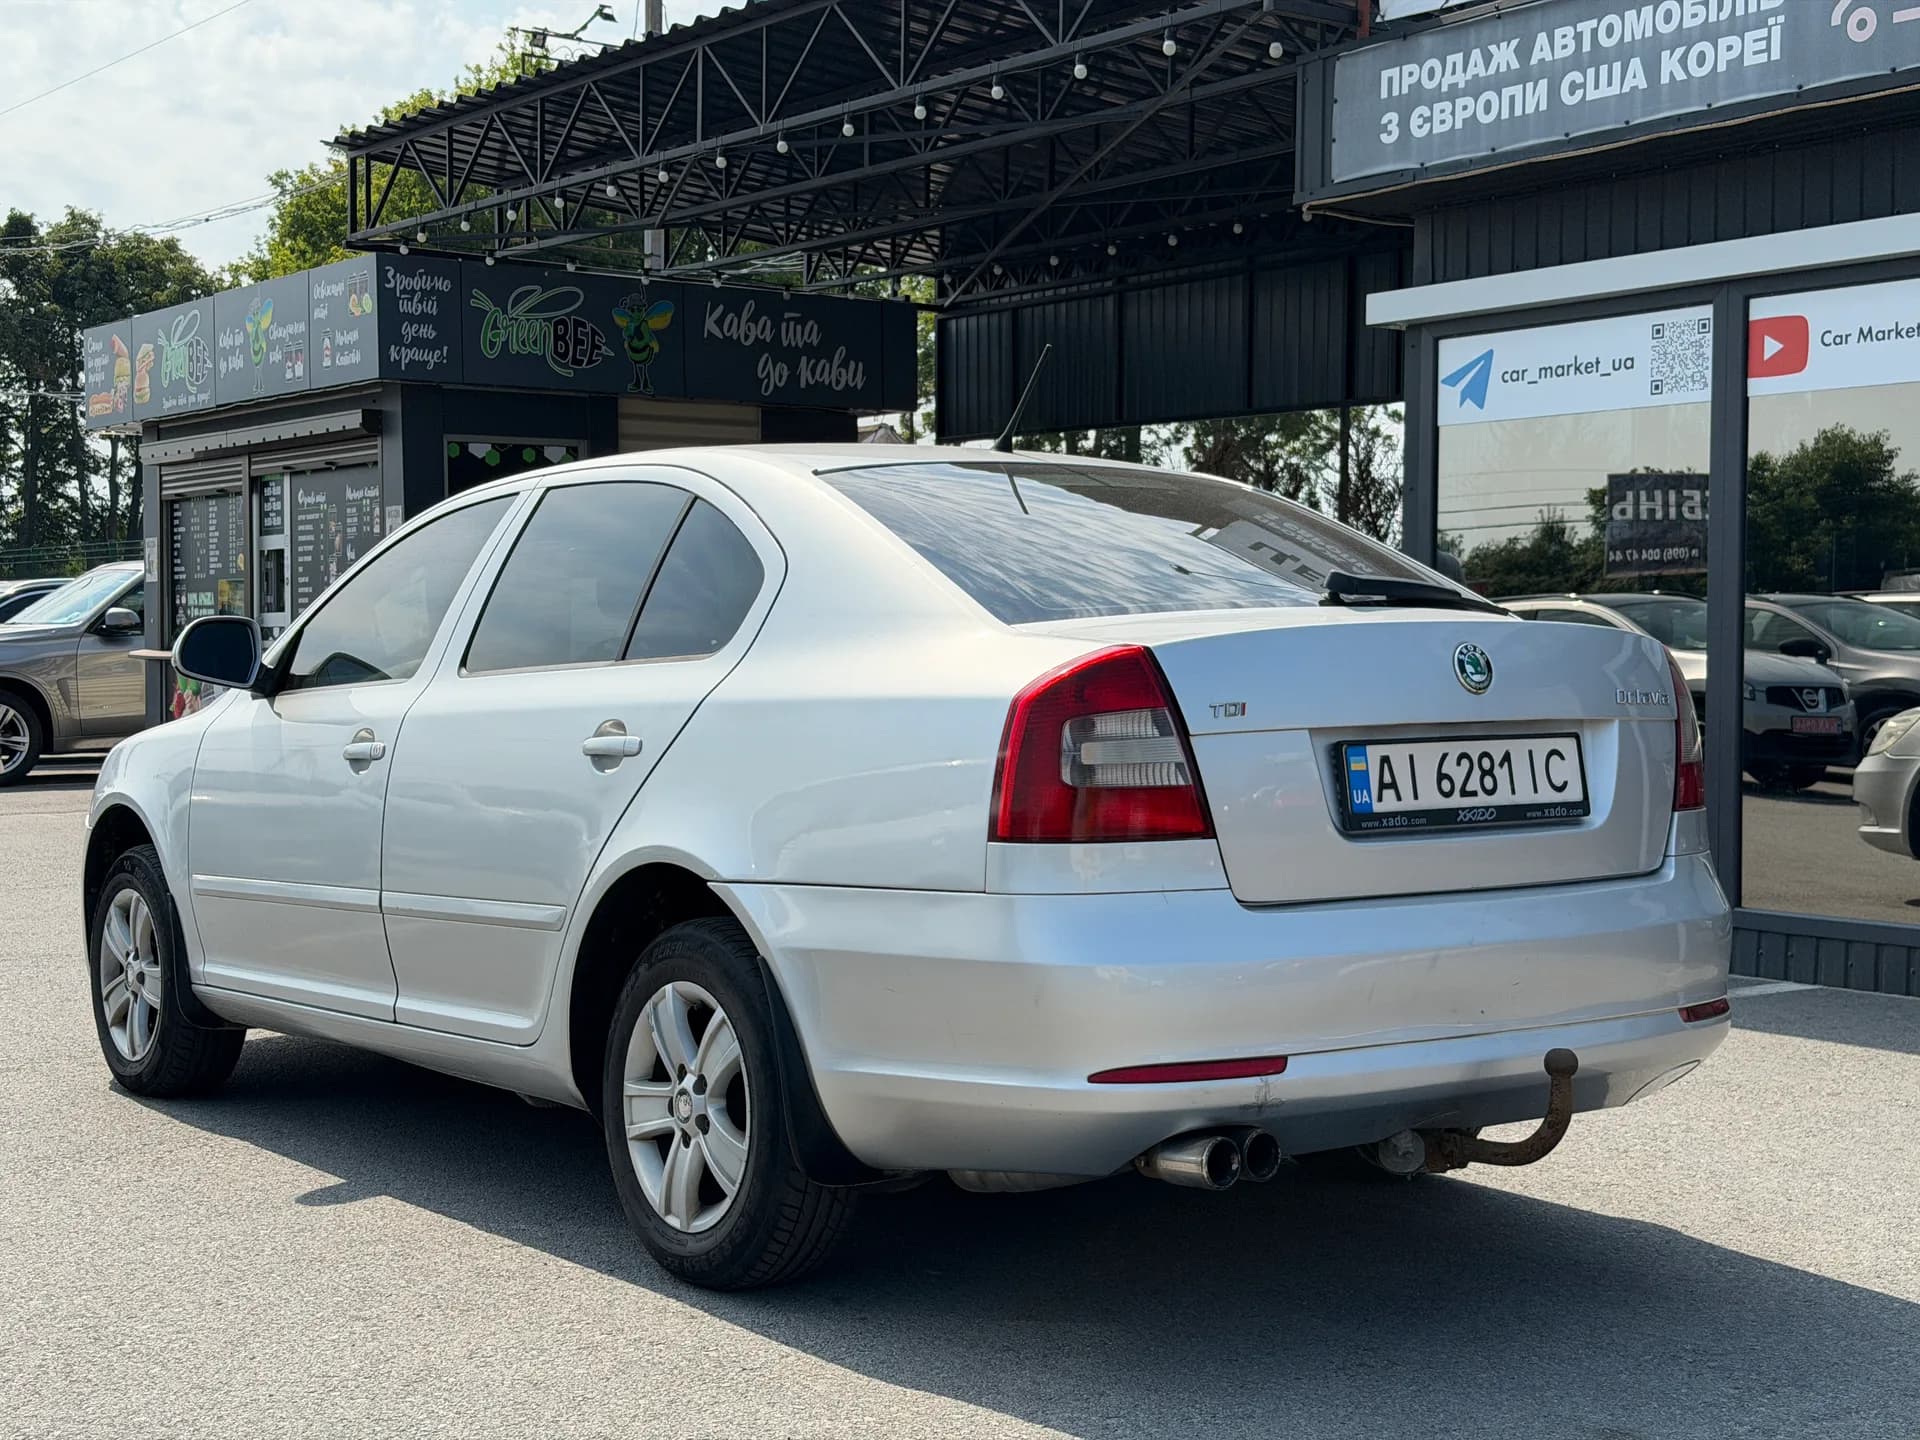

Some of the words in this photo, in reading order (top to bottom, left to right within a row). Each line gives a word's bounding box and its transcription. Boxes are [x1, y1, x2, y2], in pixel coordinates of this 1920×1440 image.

[1379, 111, 1400, 145] З
[1409, 77, 1549, 139] ЄВРОПИ
[1559, 56, 1648, 106] США
[1659, 14, 1786, 85] КОРЕЇ
[1380, 37, 1521, 100] ПРОДАЖ
[384, 265, 452, 298] Зробимо
[399, 291, 438, 316] твій
[401, 320, 438, 345] день
[703, 299, 776, 347] Кава
[780, 311, 823, 348] та
[1820, 329, 1853, 347] Car
[1856, 320, 1920, 344] Market
[388, 344, 449, 371] краще!
[756, 352, 792, 397] до
[796, 345, 868, 391] кави
[1500, 354, 1636, 385] car_market_ua
[1208, 701, 1247, 719] TDI
[1376, 752, 1419, 803] AI
[1436, 749, 1517, 799] 6281
[1528, 747, 1570, 794] IC
[1352, 789, 1371, 804] UA
[1361, 814, 1427, 828] www.xado.com
[1525, 804, 1584, 818] www.xado.com
